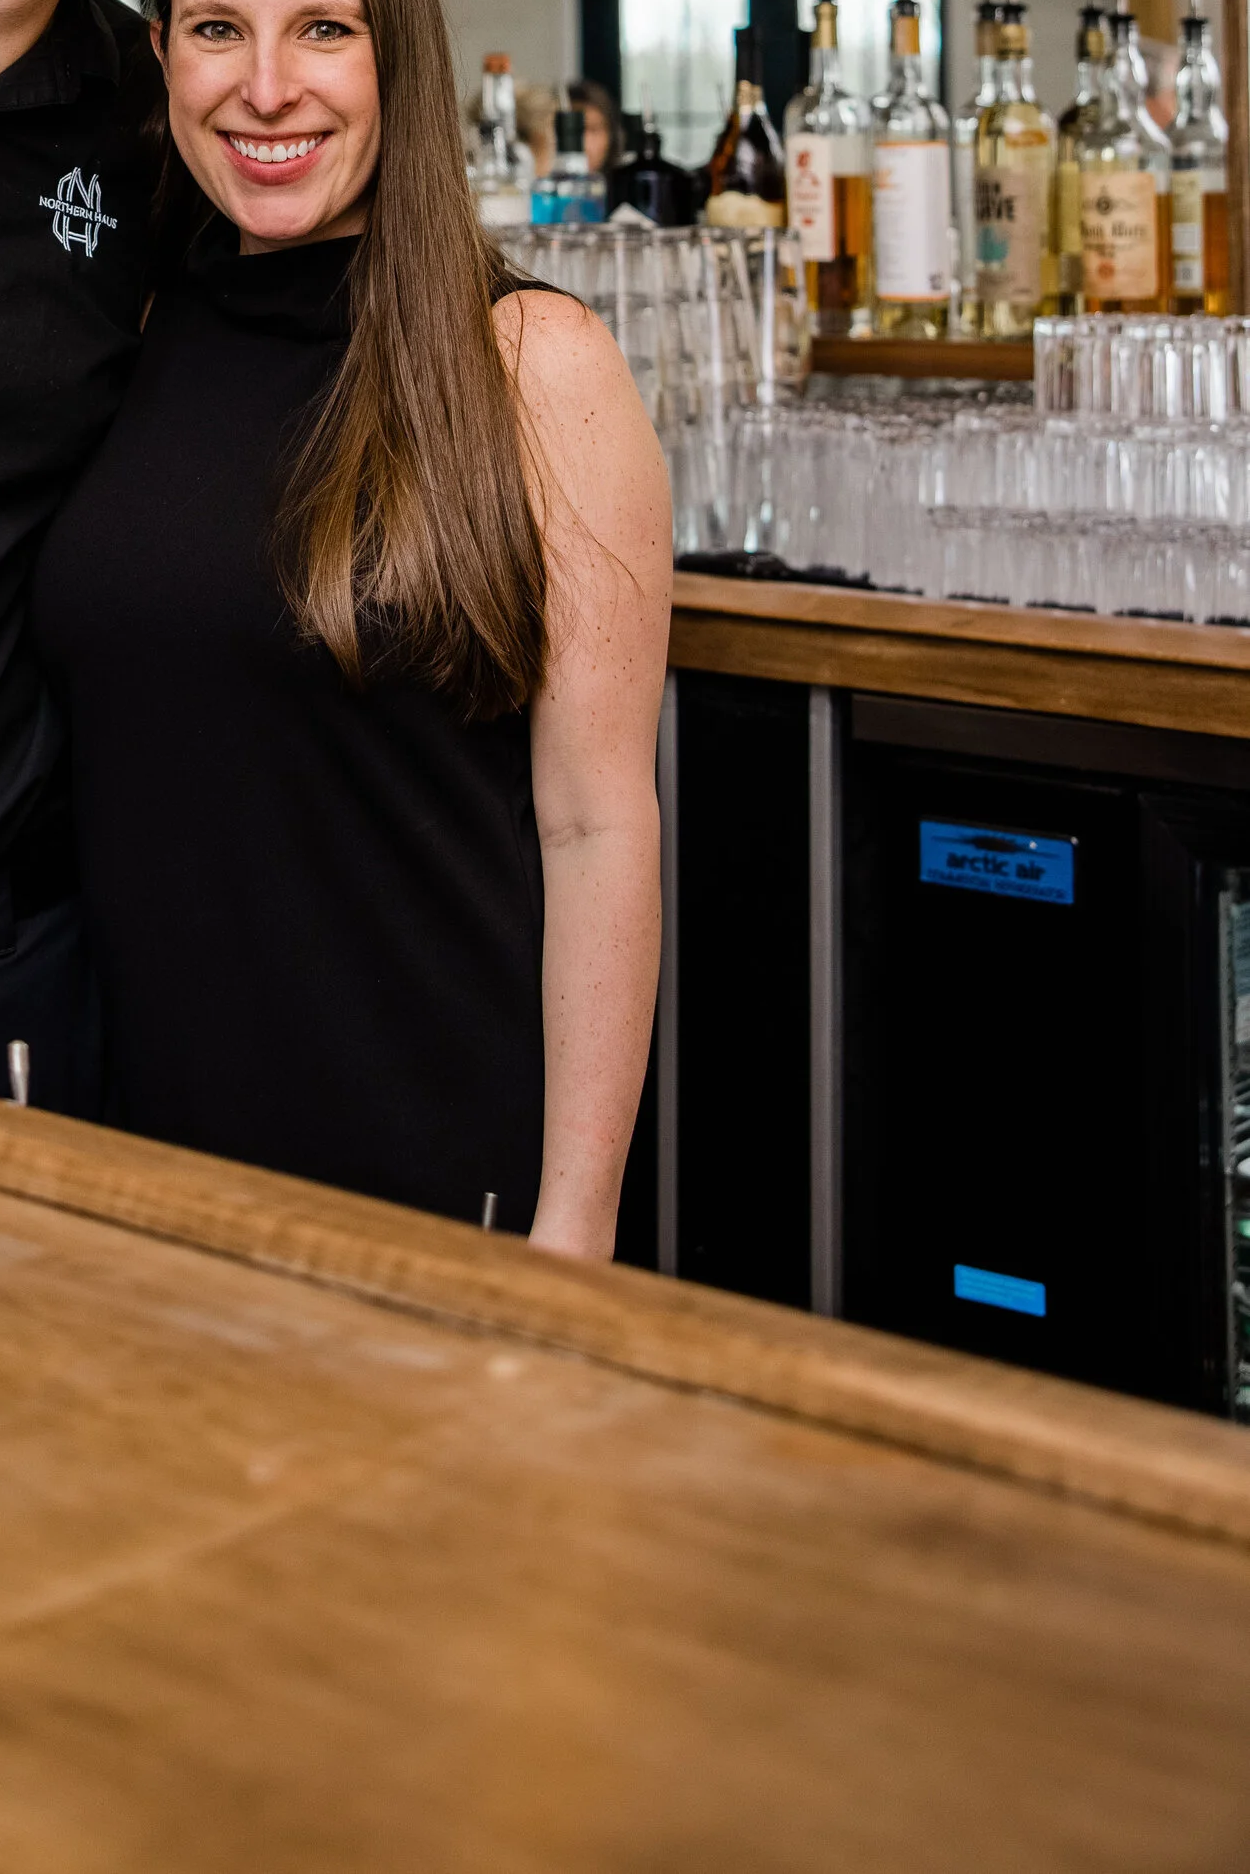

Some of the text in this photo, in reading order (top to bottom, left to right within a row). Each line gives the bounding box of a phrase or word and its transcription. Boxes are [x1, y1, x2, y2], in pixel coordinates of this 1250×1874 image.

[39, 195, 118, 229] NORTHERN HAUS
[946, 851, 1046, 882] arctic air
